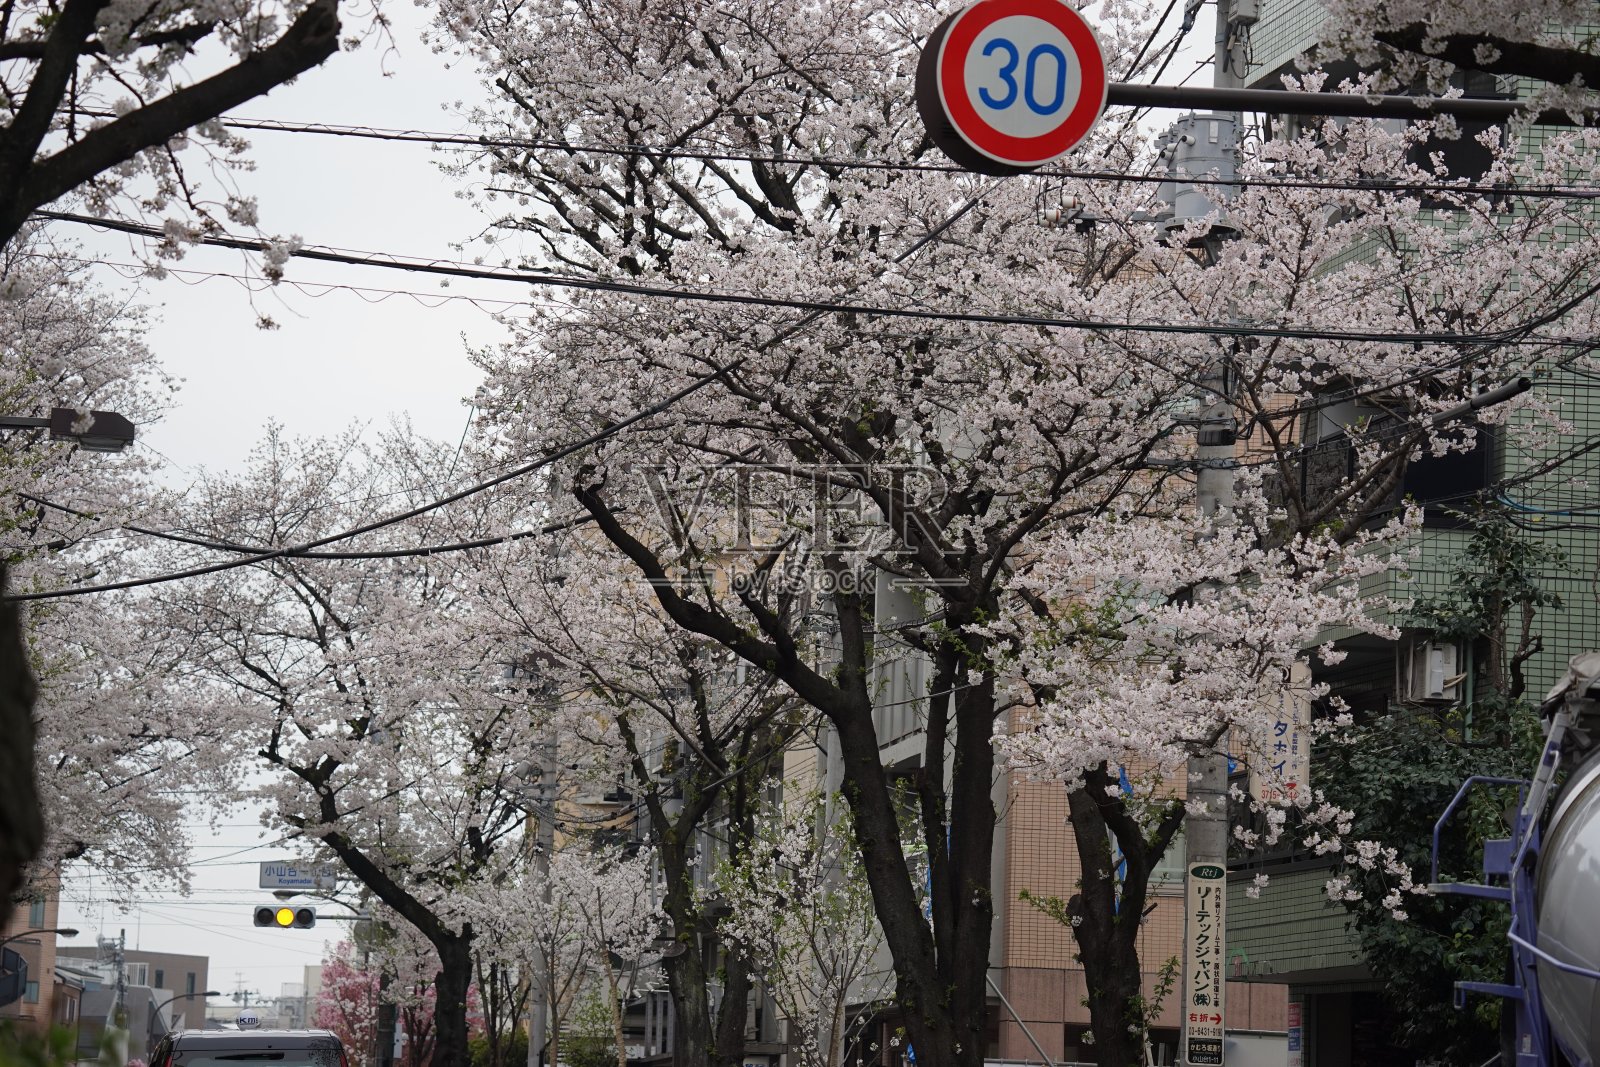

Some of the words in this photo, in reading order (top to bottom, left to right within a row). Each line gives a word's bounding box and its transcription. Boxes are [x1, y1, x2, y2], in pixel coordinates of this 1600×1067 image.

[978, 38, 1067, 116] 30
[1201, 868, 1218, 878] Rtj
[278, 878, 313, 886] Koyamadai
[1189, 1012, 1209, 1023] 右折
